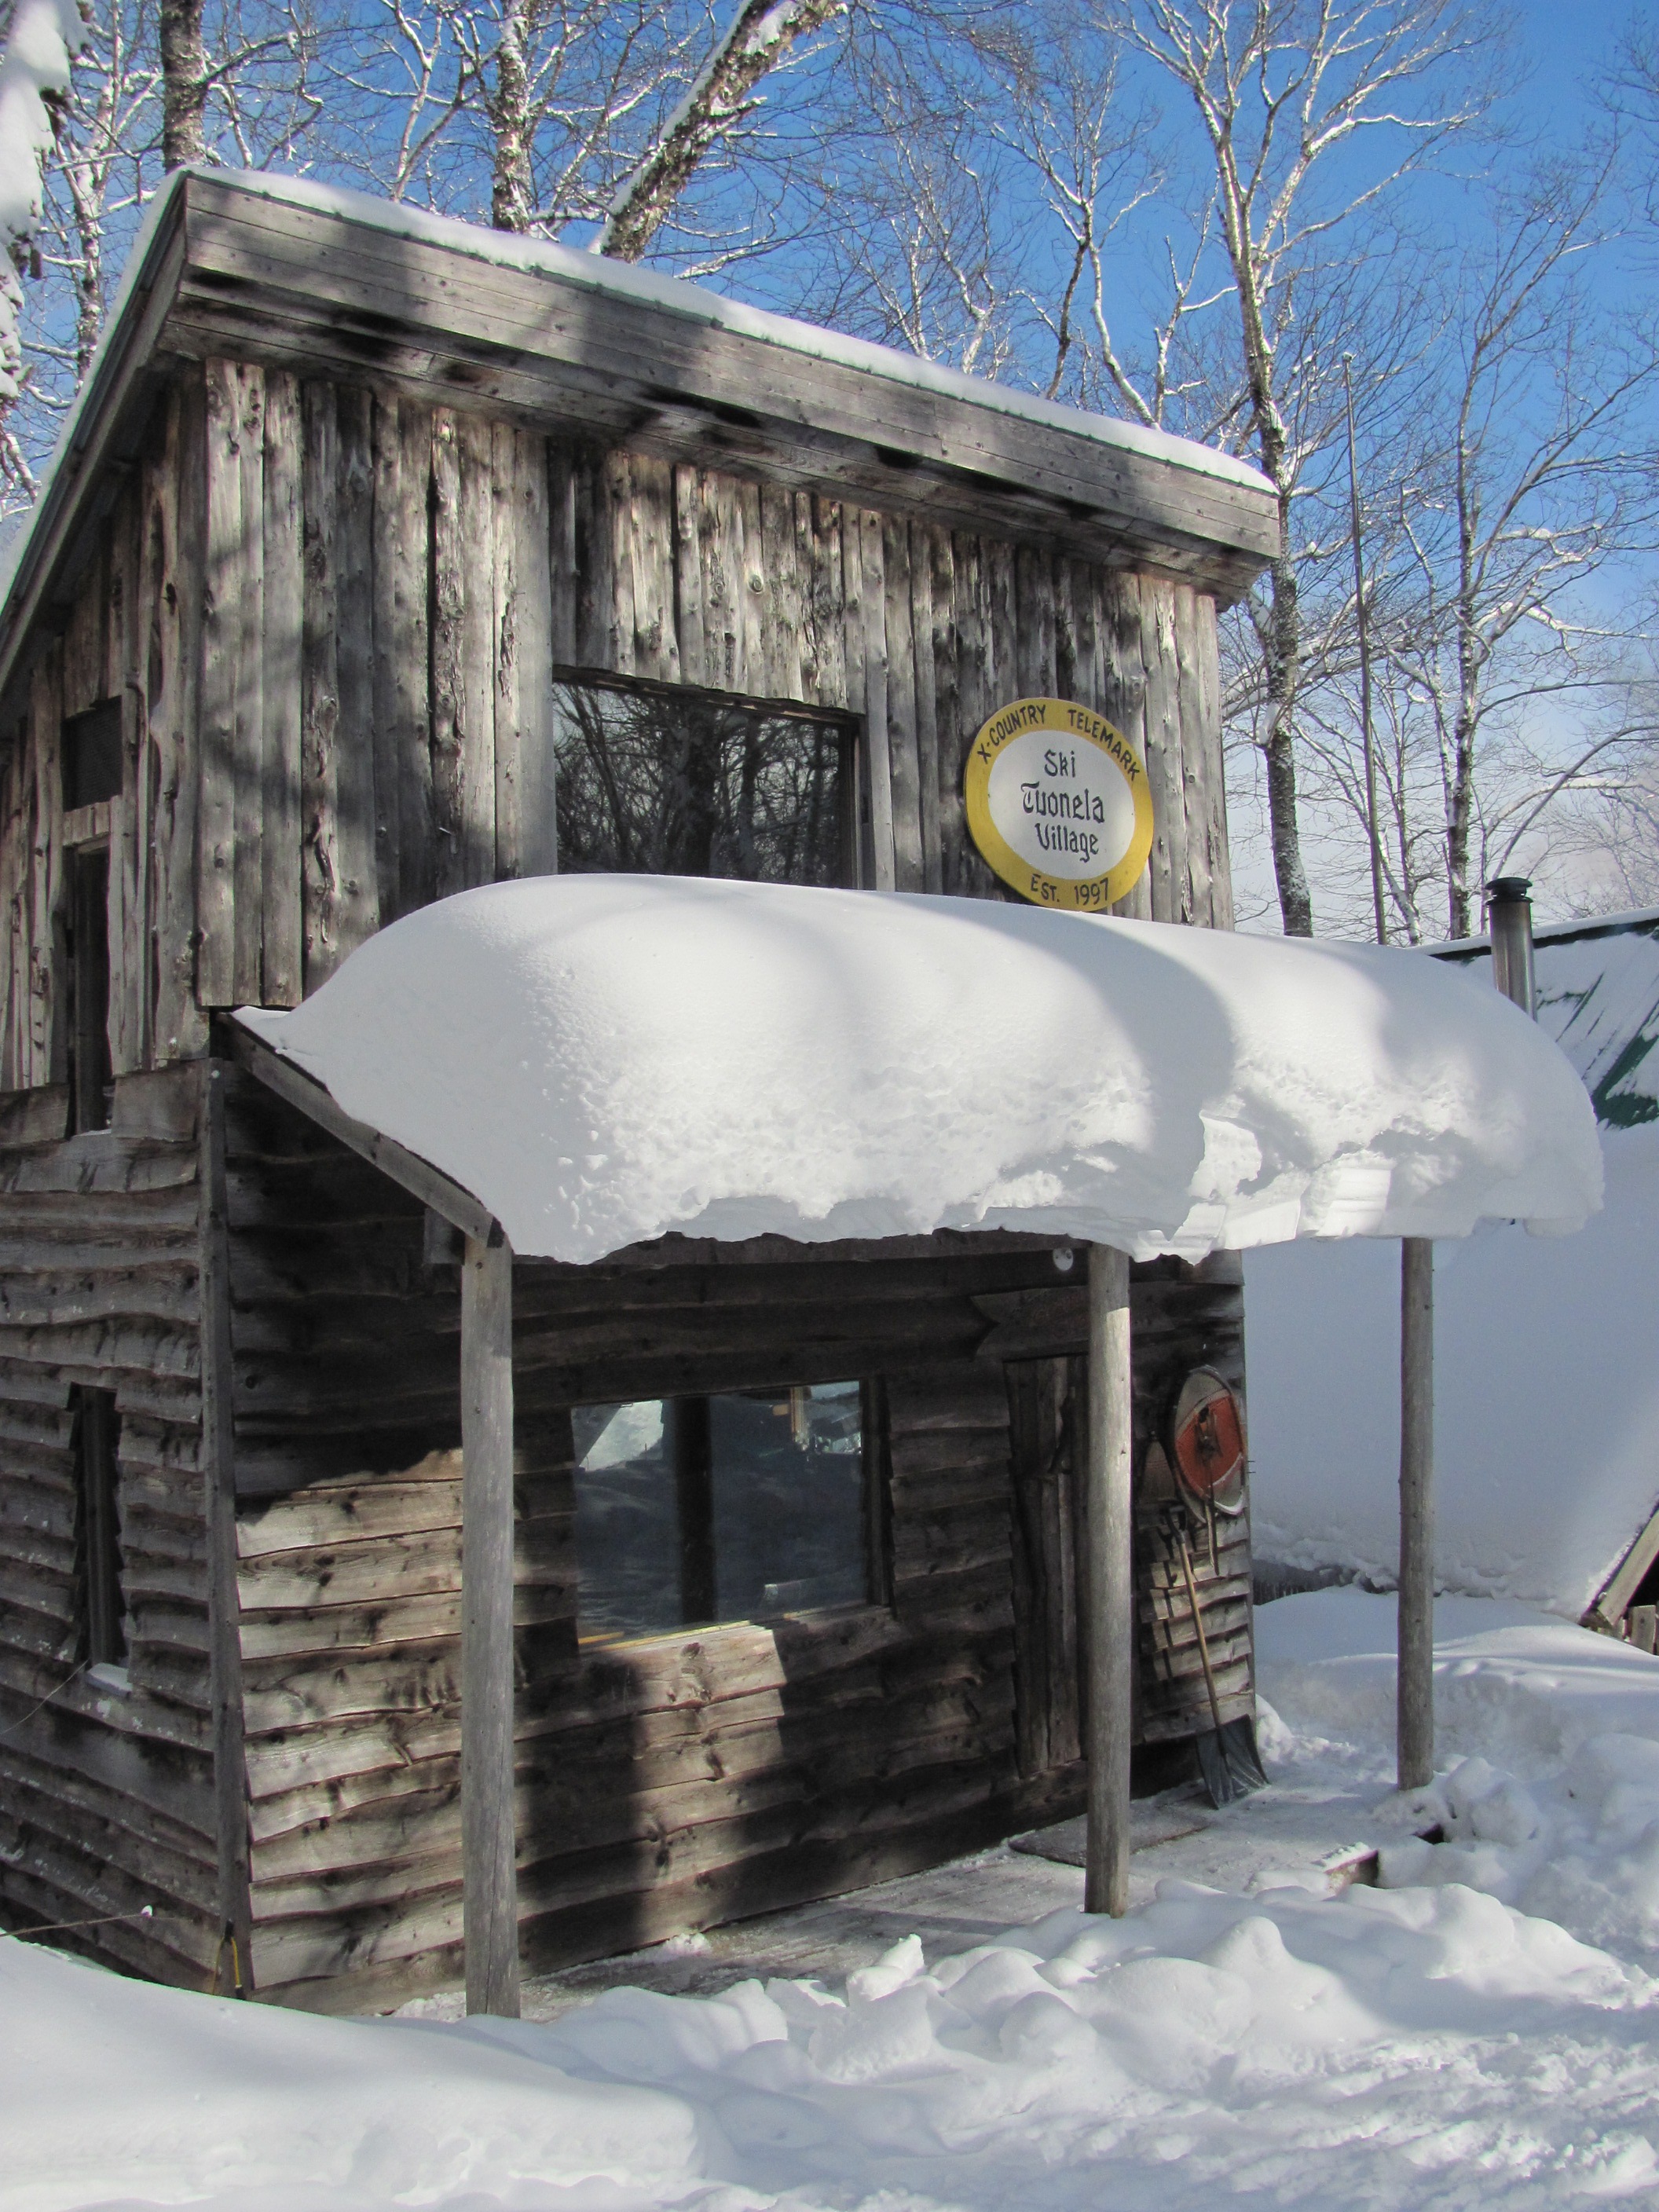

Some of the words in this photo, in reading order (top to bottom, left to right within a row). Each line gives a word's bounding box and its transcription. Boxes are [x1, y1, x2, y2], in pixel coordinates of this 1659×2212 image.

[977, 705, 1046, 764] X-COUNTRY
[1068, 709, 1140, 781] TELEMARK
[1044, 749, 1076, 778] Ski
[1020, 781, 1105, 823] Tuonela
[1035, 822, 1100, 862] Village
[1074, 879, 1109, 906] 1997
